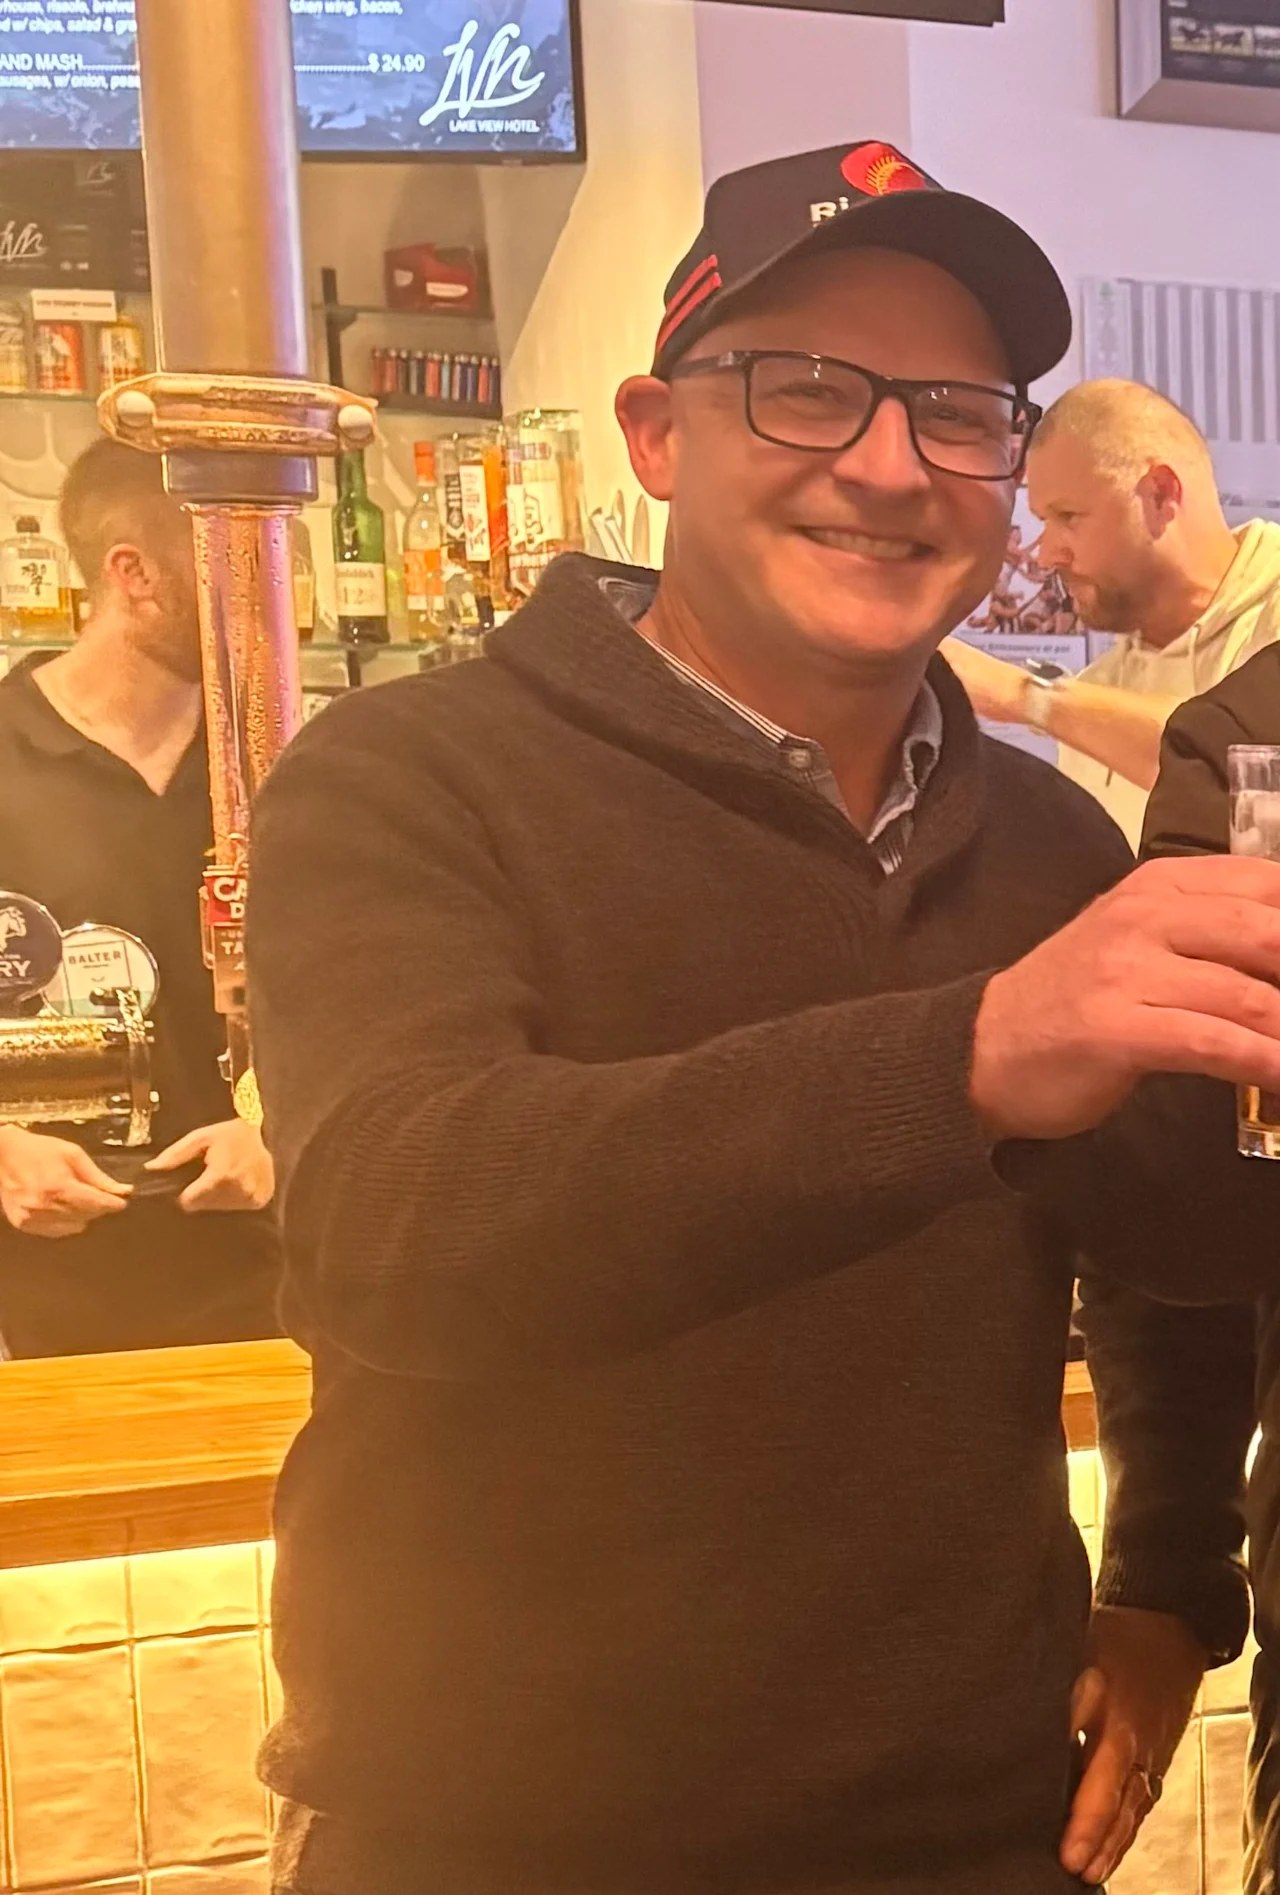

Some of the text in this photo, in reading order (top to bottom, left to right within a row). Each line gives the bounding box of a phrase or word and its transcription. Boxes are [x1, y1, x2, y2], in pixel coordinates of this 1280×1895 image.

[0, 52, 33, 71] AND
[504, 119, 540, 133] HOTEL
[68, 949, 122, 965] BALTER
